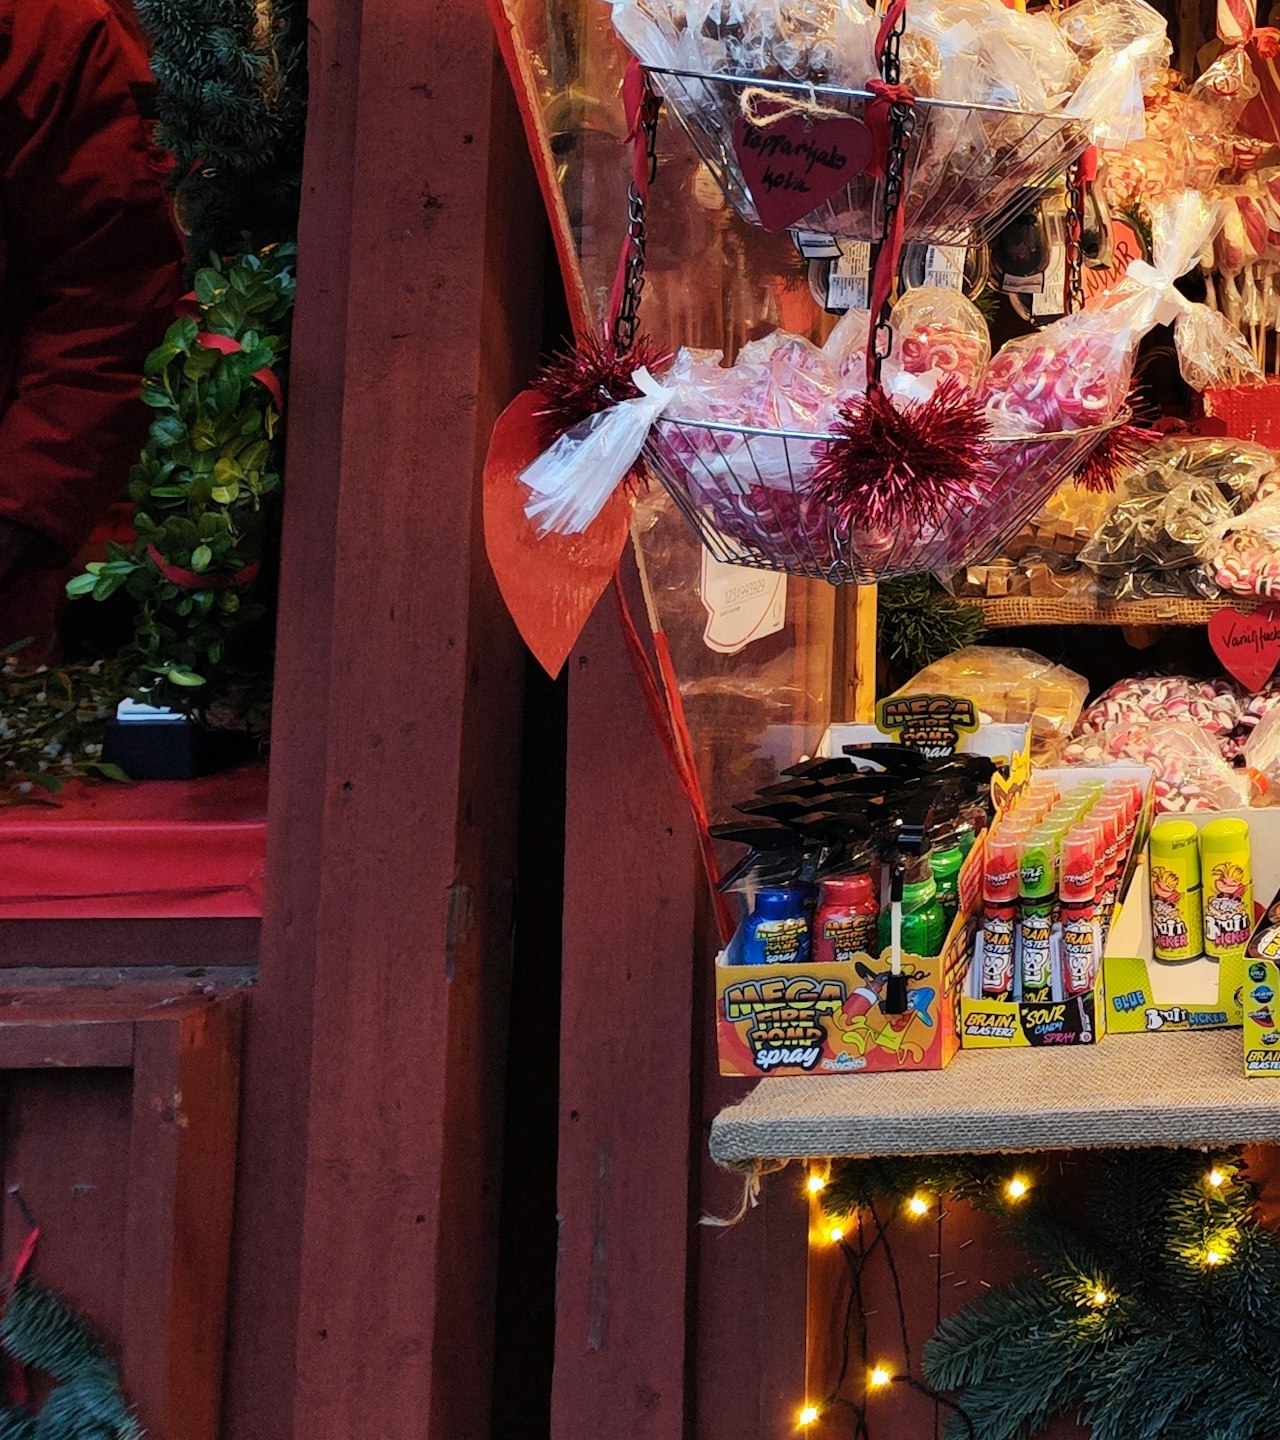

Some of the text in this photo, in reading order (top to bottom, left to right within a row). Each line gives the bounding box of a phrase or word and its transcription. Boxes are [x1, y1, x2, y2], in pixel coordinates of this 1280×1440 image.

[885, 698, 972, 726] MEGA
[729, 979, 844, 1019] MEGA
[1113, 990, 1146, 1013] BLUE
[756, 1009, 816, 1030] FIRE
[965, 1013, 1013, 1029] BRAIN
[1025, 1004, 1066, 1029] SOUR
[1146, 1007, 1228, 1030] Brain LICKER
[966, 1025, 1017, 1038] BLASTERZ
[1034, 1021, 1064, 1035] CANDY
[1043, 1031, 1076, 1044] SPRAY
[755, 1047, 821, 1069] spray
